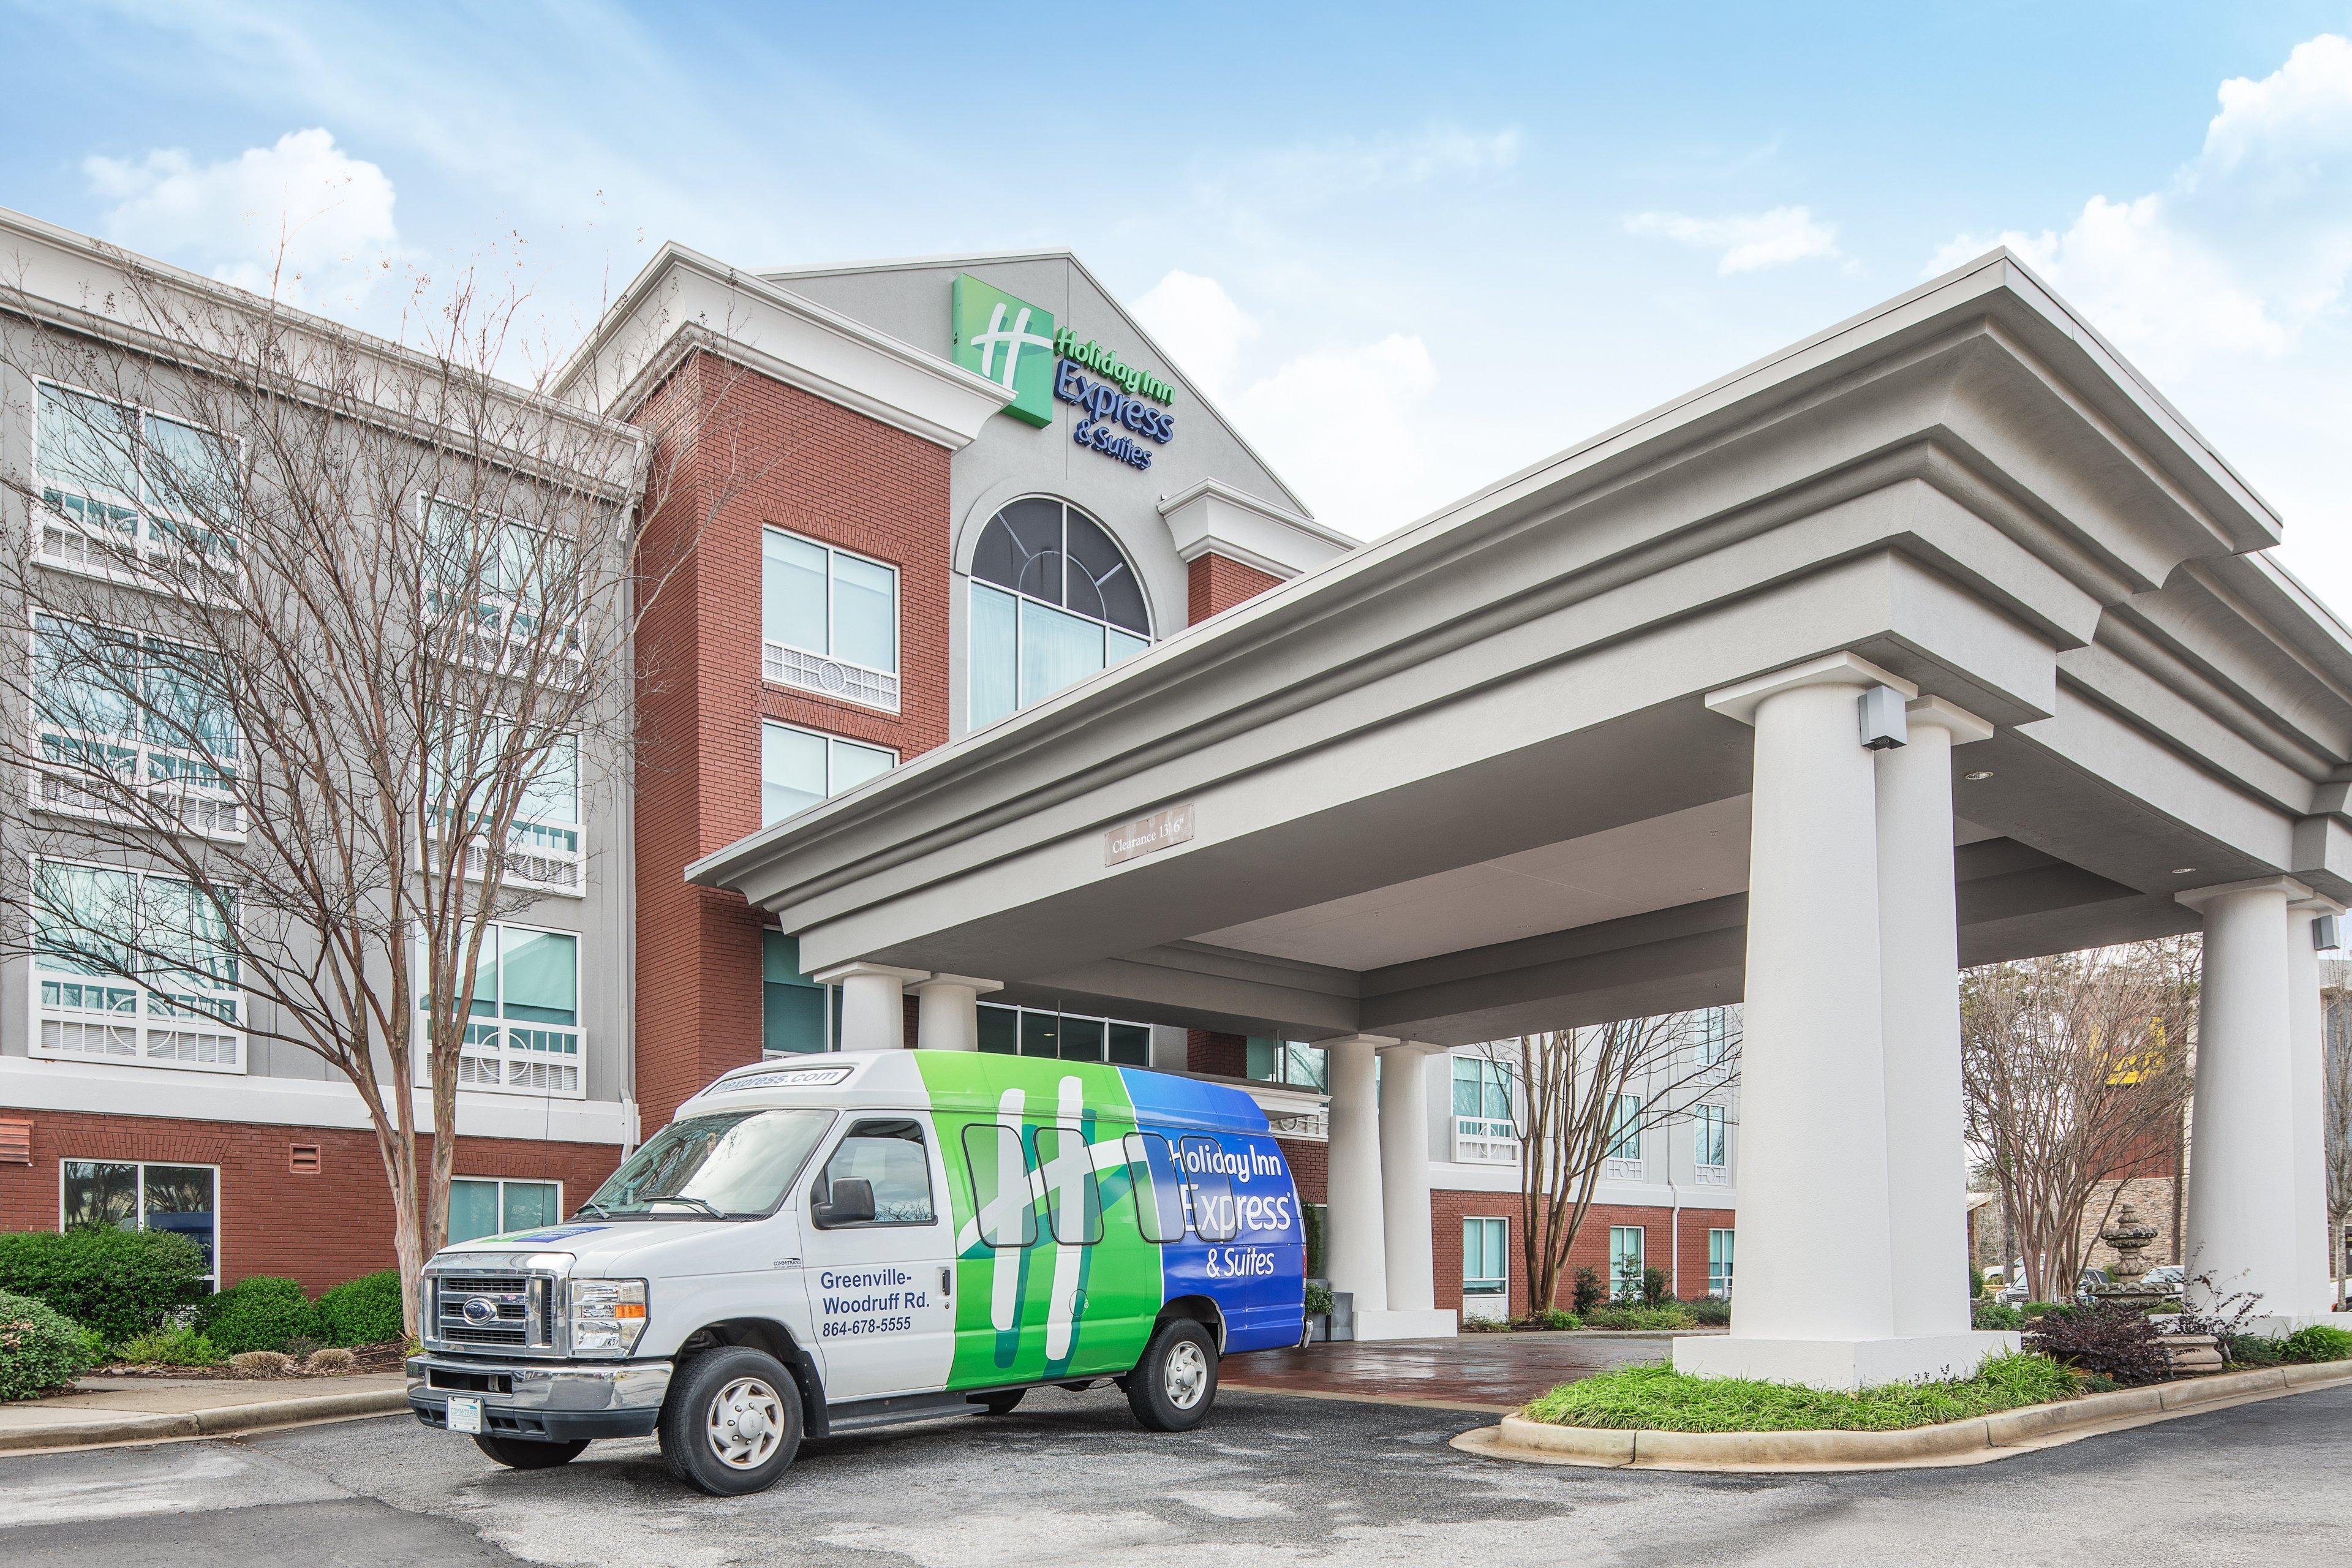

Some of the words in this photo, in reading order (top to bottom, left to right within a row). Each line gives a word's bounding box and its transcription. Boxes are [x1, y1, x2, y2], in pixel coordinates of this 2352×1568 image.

[1054, 326, 1141, 396] Holiday
[1138, 369, 1175, 407] Inn
[1054, 358, 1175, 444] Express
[1073, 418, 1092, 447] &
[1091, 426, 1153, 470] Suites
[1112, 832, 1156, 853] Clearance
[1168, 1140, 1250, 1183] Holiday
[1249, 1144, 1282, 1176] Inn
[1180, 1184, 1291, 1244] Express
[821, 1268, 911, 1289] Greenville-
[1205, 1248, 1221, 1278] &
[1224, 1247, 1275, 1277] Suites
[823, 1293, 900, 1314] Woodruff
[905, 1291, 930, 1309] Rd.
[823, 1316, 911, 1337] 864-678-5555
